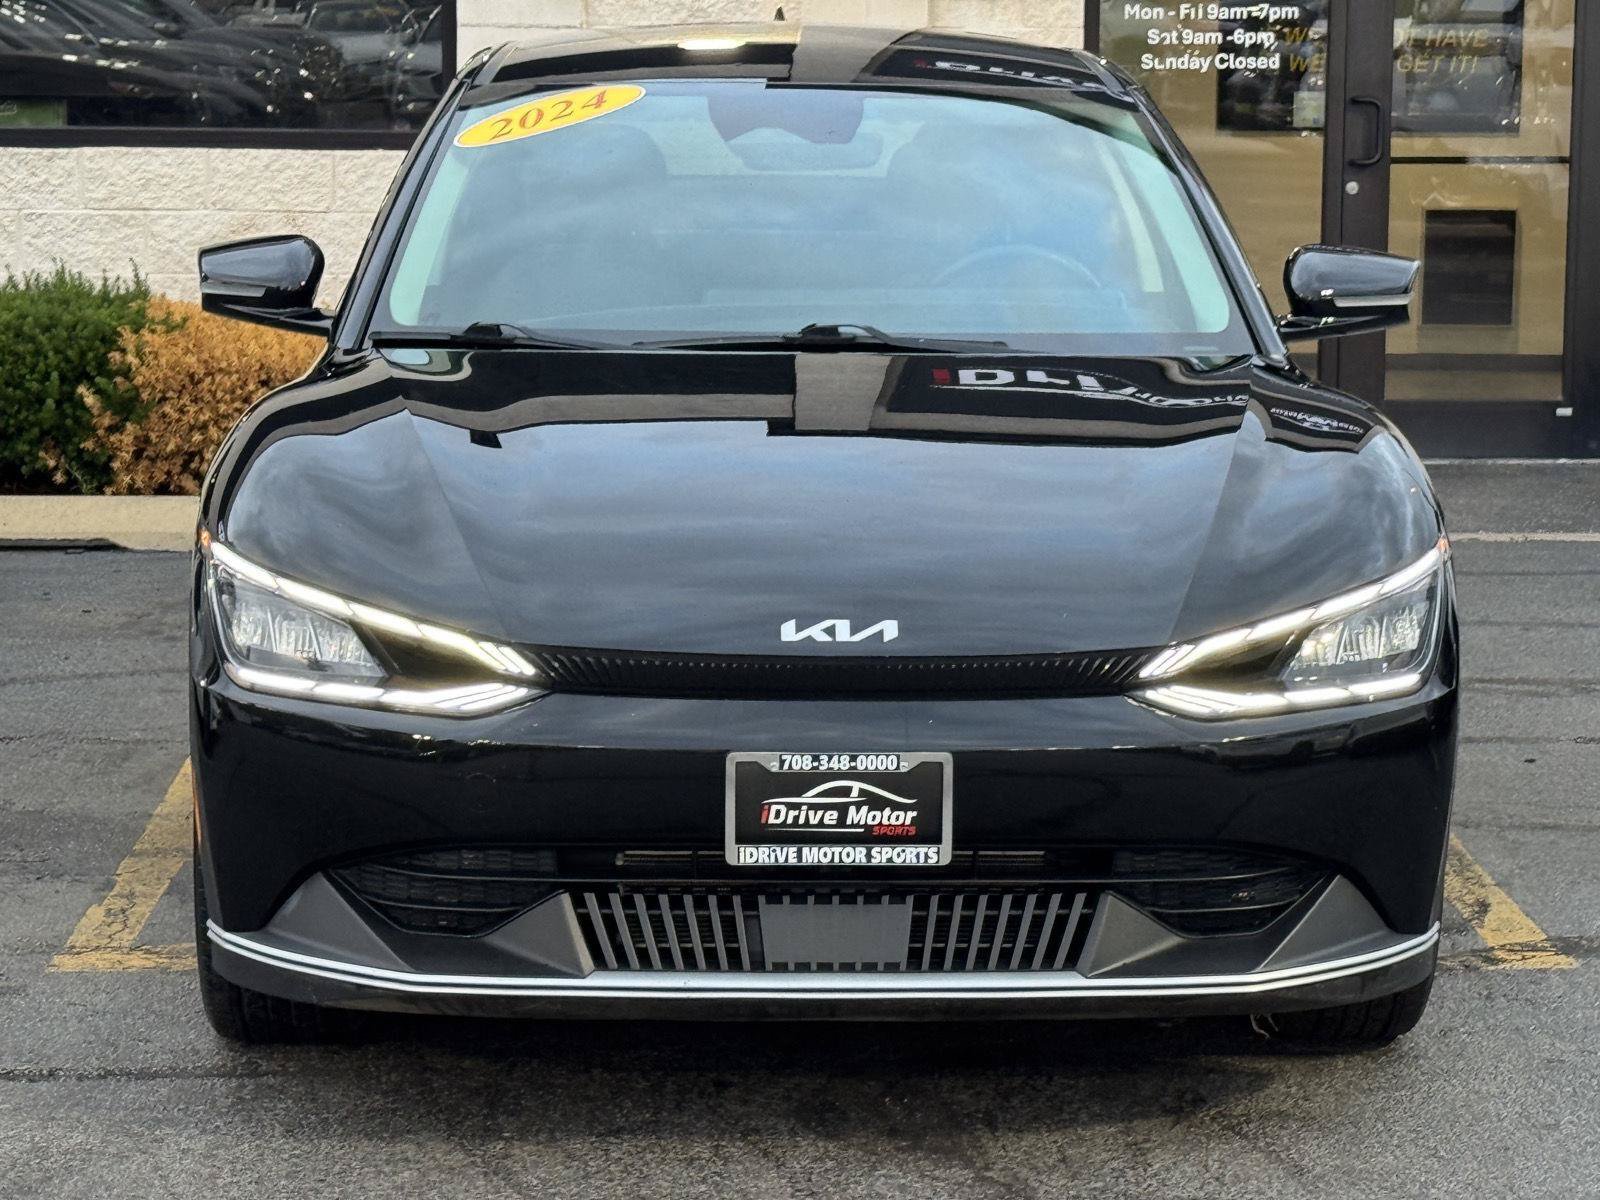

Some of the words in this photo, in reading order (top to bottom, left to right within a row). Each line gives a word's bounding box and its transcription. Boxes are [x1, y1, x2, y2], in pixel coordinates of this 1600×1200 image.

[1124, 4, 1164, 20] Mon
[1147, 28, 1179, 45] Sat
[1141, 53, 1213, 73] Sunday
[1214, 52, 1280, 70] Closed
[1397, 54, 1446, 73] GET
[489, 89, 607, 141] 2024
[781, 754, 898, 771] 708-348-0000
[760, 804, 838, 825] iDrive
[846, 805, 918, 826] Motor
[872, 826, 917, 836] SPORTS
[802, 847, 866, 865] MOTOR
[871, 847, 939, 865] SPORTS
